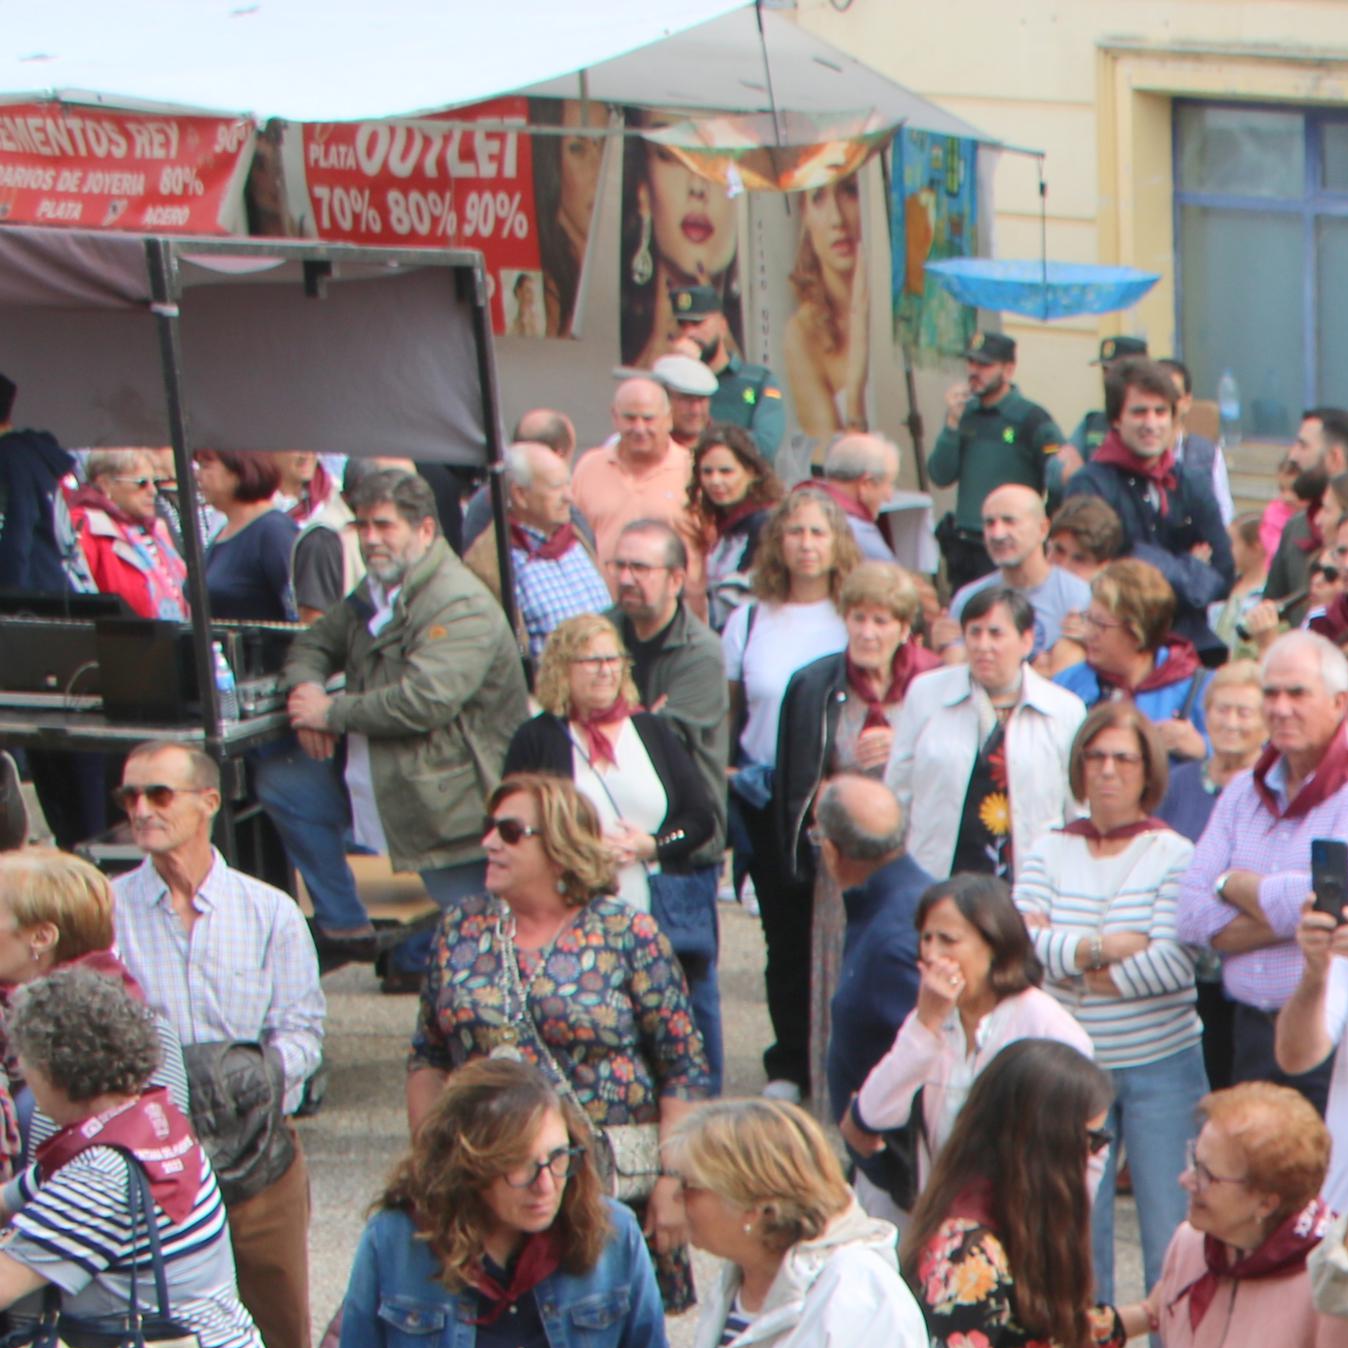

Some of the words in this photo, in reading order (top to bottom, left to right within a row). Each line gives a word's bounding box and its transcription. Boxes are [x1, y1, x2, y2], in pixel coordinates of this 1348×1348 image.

[127, 121, 180, 160] REY
[354, 117, 528, 179] OUTLET
[309, 142, 357, 171] PLATA
[0, 164, 56, 192] ARIOS
[56, 167, 84, 193] DE
[159, 165, 205, 197] 80%
[36, 198, 84, 221] PLATA
[141, 206, 191, 227] ACERO
[313, 186, 382, 234] 70%
[387, 188, 457, 236] 80%
[463, 190, 529, 240] 90%
